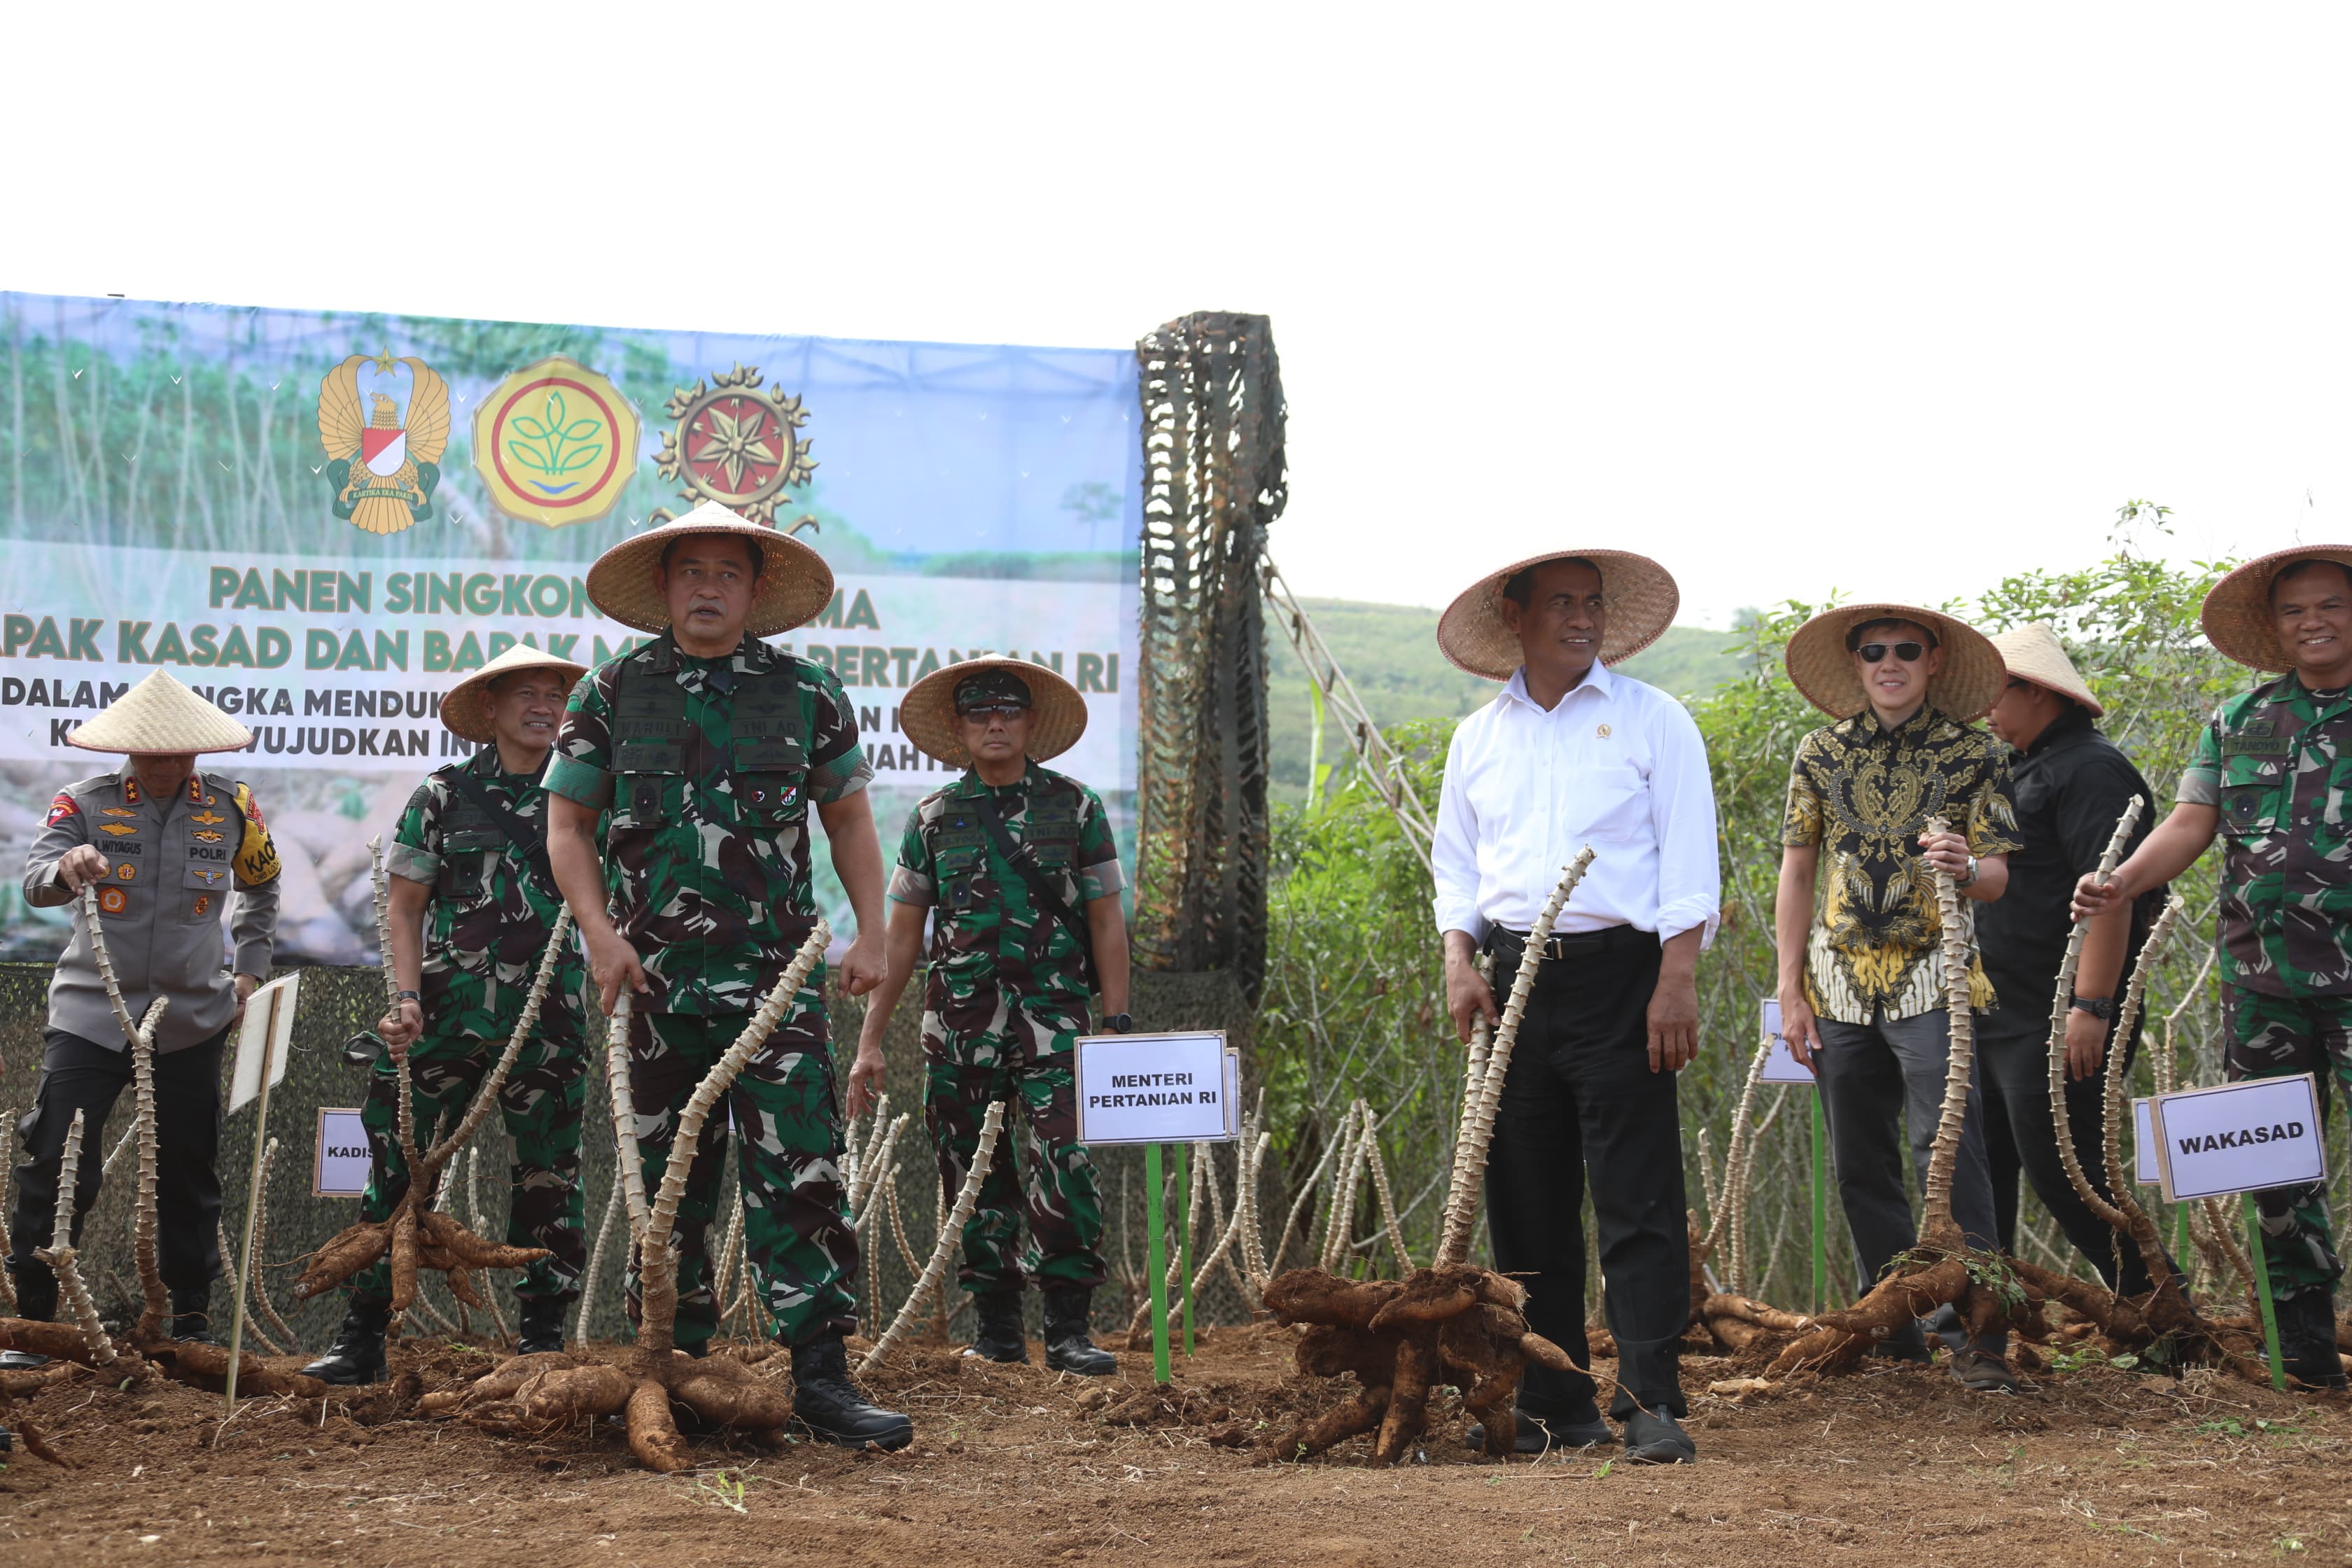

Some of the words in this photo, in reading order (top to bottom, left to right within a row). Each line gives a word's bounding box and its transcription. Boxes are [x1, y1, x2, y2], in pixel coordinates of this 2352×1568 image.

[353, 489, 380, 499] KARTIKA
[382, 489, 394, 497] EKA
[210, 566, 372, 614] PANEN
[384, 571, 604, 620] SINGKON
[0, 614, 104, 662] PAK
[118, 620, 293, 669] KASAD
[305, 628, 410, 672] DAN
[1077, 651, 1120, 694] RI
[1, 677, 130, 709] DALAM
[192, 685, 294, 716] NGKA
[304, 690, 448, 719] MENDUK
[743, 720, 766, 734] TNI
[777, 720, 796, 735] AD
[2234, 741, 2280, 751] TANDYO
[190, 846, 226, 861] POLRI
[1112, 1072, 1193, 1088] MENTERI
[1090, 1092, 1192, 1108] PERTANIAN
[1199, 1091, 1217, 1104] RI
[2178, 1121, 2304, 1155] WAKASAD
